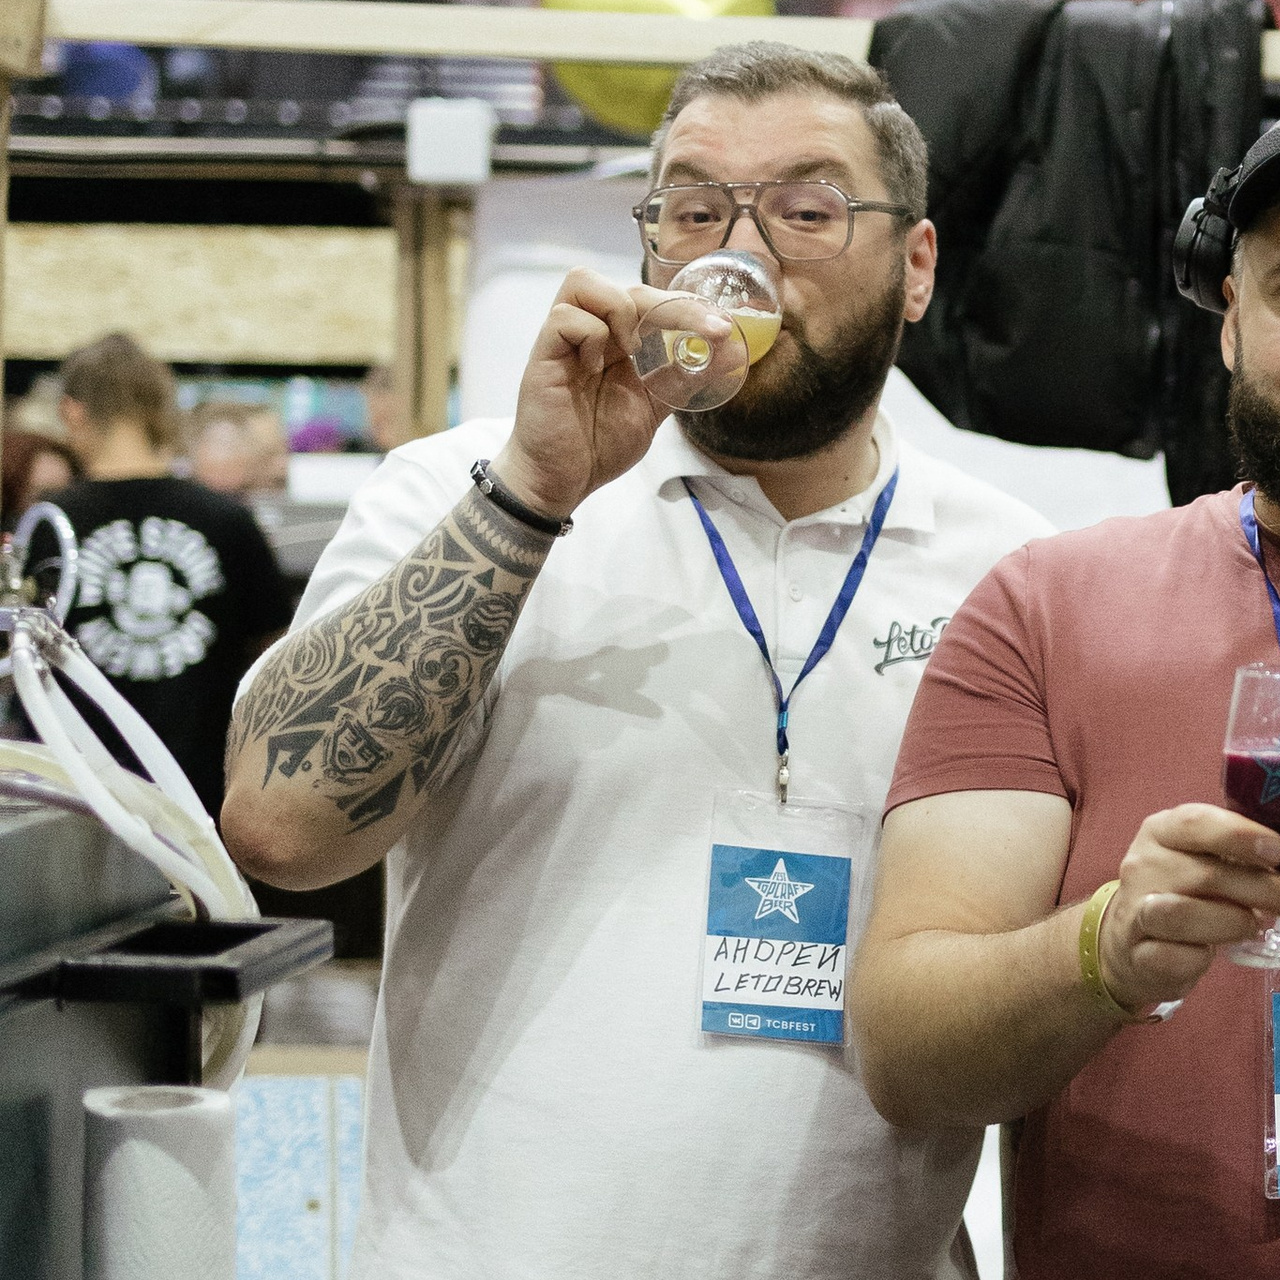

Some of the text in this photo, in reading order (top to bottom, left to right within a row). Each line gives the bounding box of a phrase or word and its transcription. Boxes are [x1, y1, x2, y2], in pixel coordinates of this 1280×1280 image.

[772, 871, 787, 881] FEST
[747, 879, 812, 900] TOPCRAFT
[757, 898, 798, 921] BEER
[713, 972, 843, 1002] LETOBREW
[765, 1019, 817, 1032] TCBFEST
